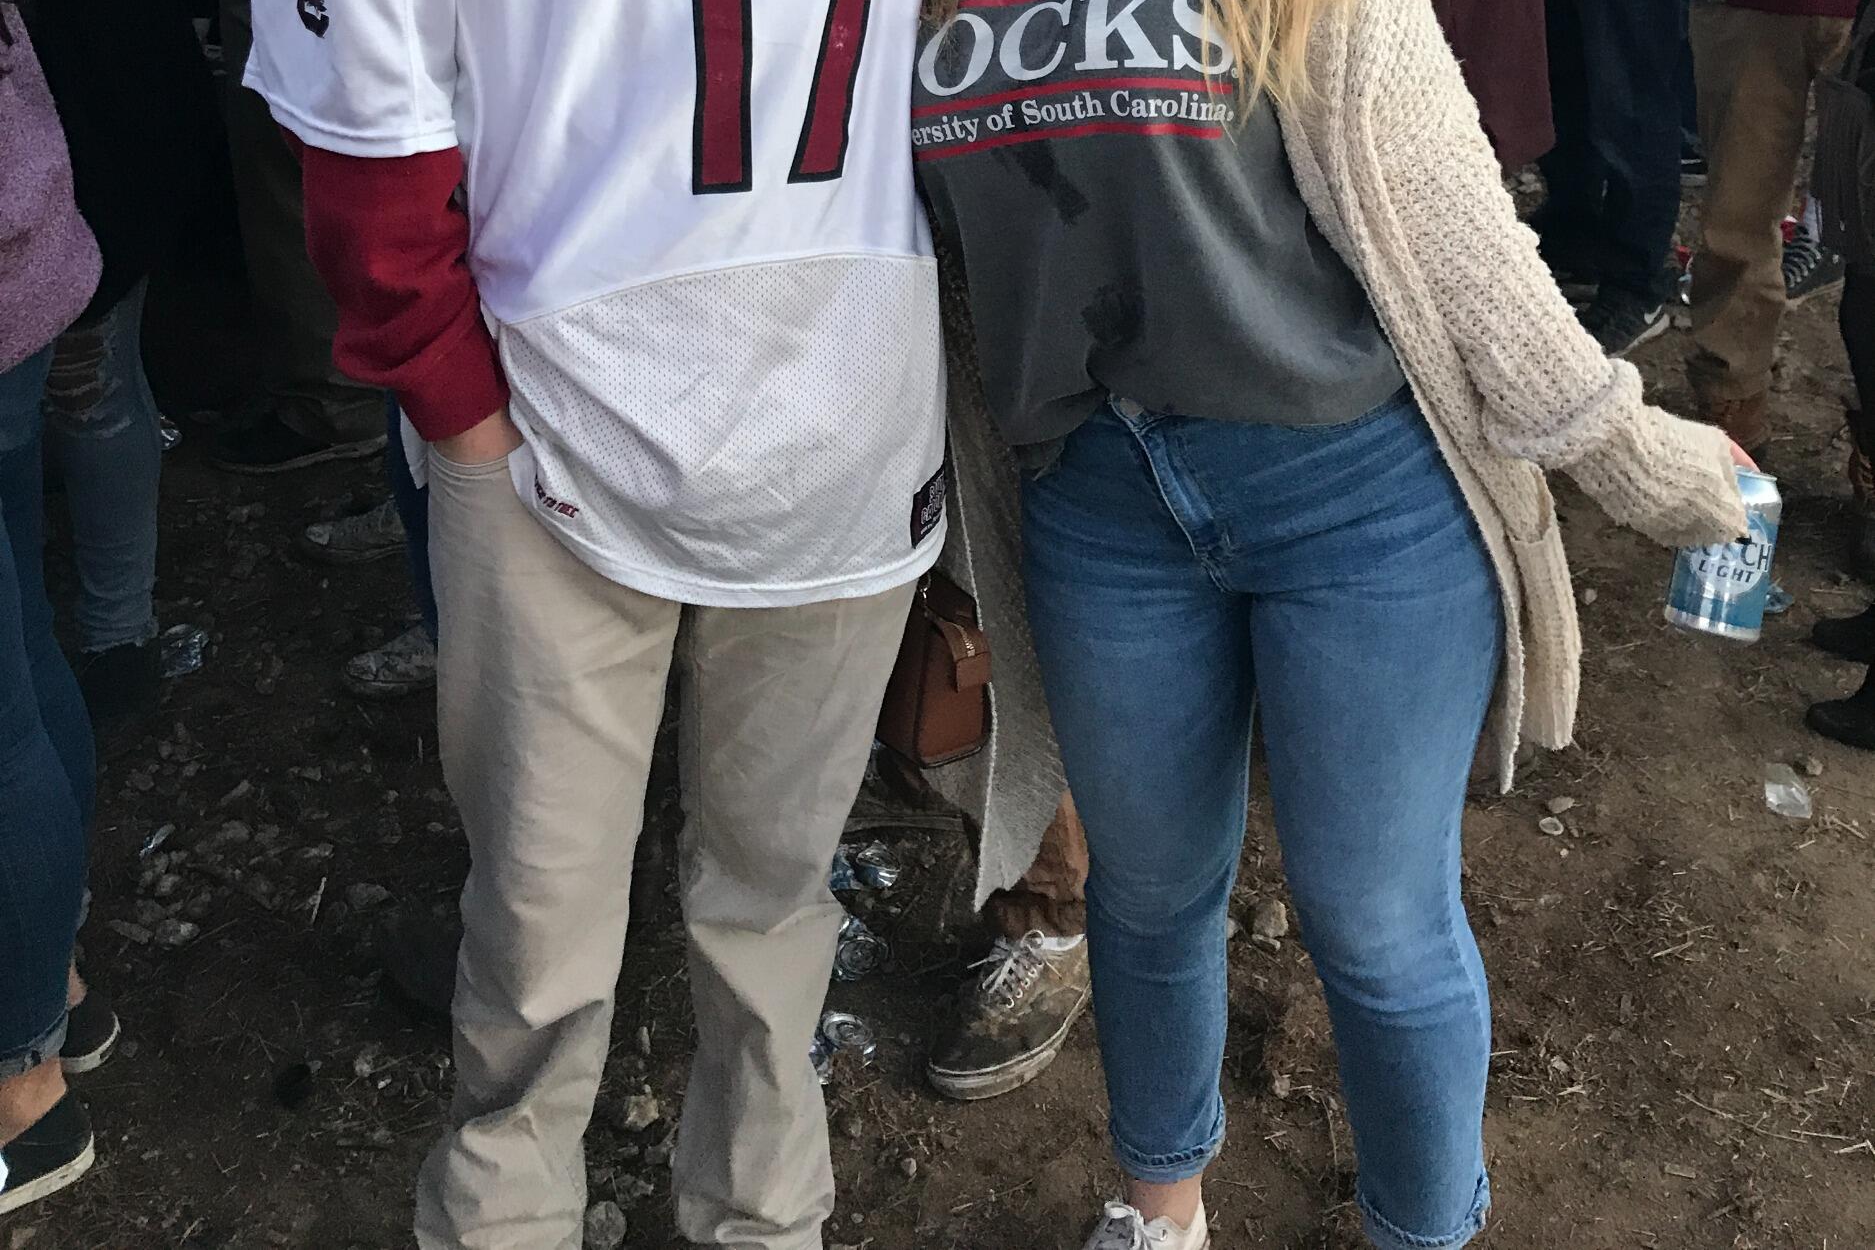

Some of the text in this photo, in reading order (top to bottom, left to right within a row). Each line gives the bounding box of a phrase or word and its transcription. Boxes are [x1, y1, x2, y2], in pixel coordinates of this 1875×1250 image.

[986, 103, 1016, 132] of
[1022, 91, 1106, 127] South
[1109, 90, 1228, 123] Carolina
